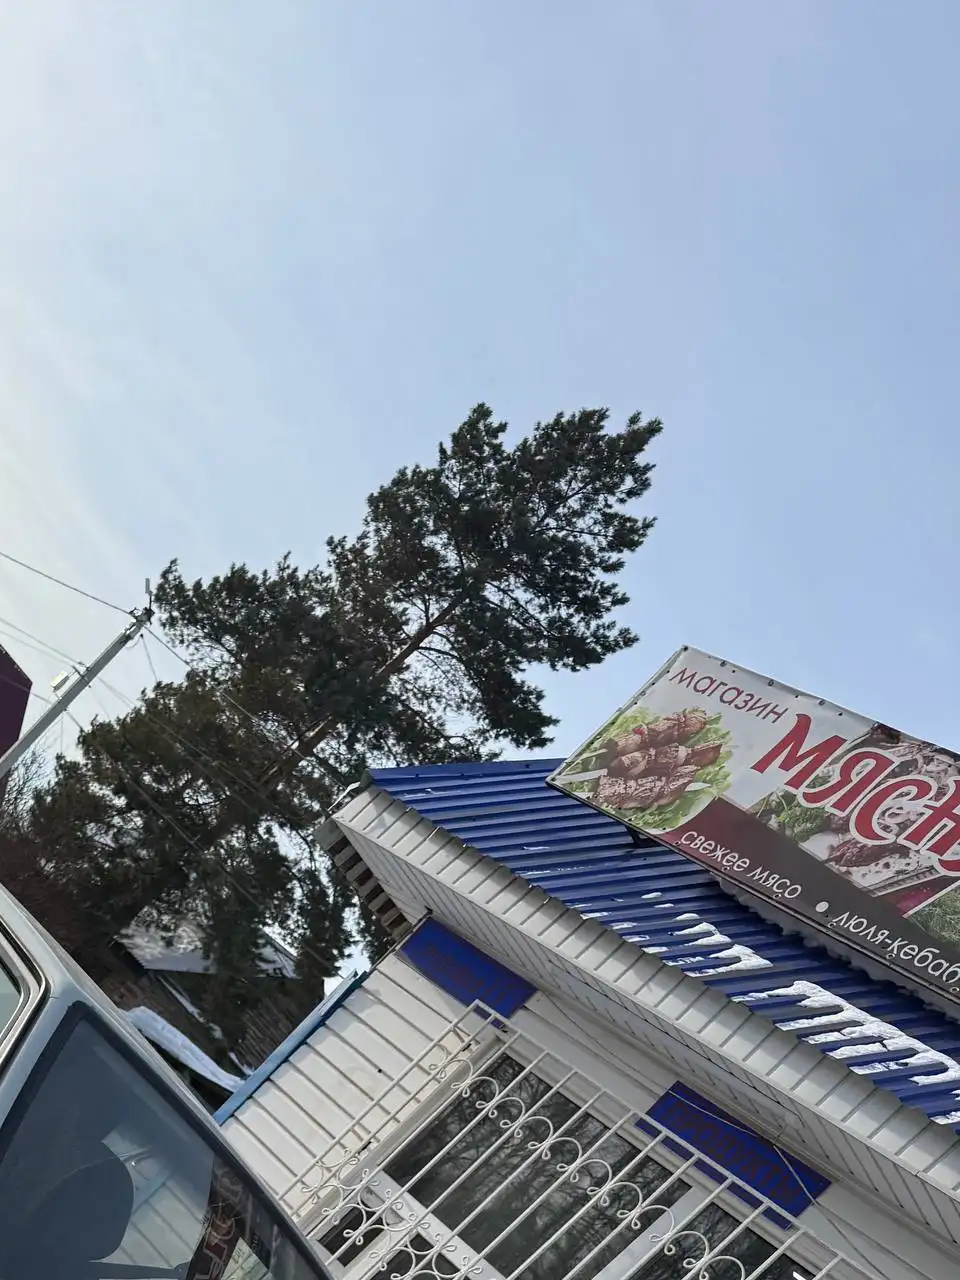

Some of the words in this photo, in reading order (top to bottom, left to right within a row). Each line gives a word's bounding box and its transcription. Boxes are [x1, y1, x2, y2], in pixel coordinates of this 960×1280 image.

[669, 667, 789, 723] магазин
[751, 713, 960, 874] МЯСН
[680, 831, 750, 871] свежее
[746, 864, 802, 898] мясо
